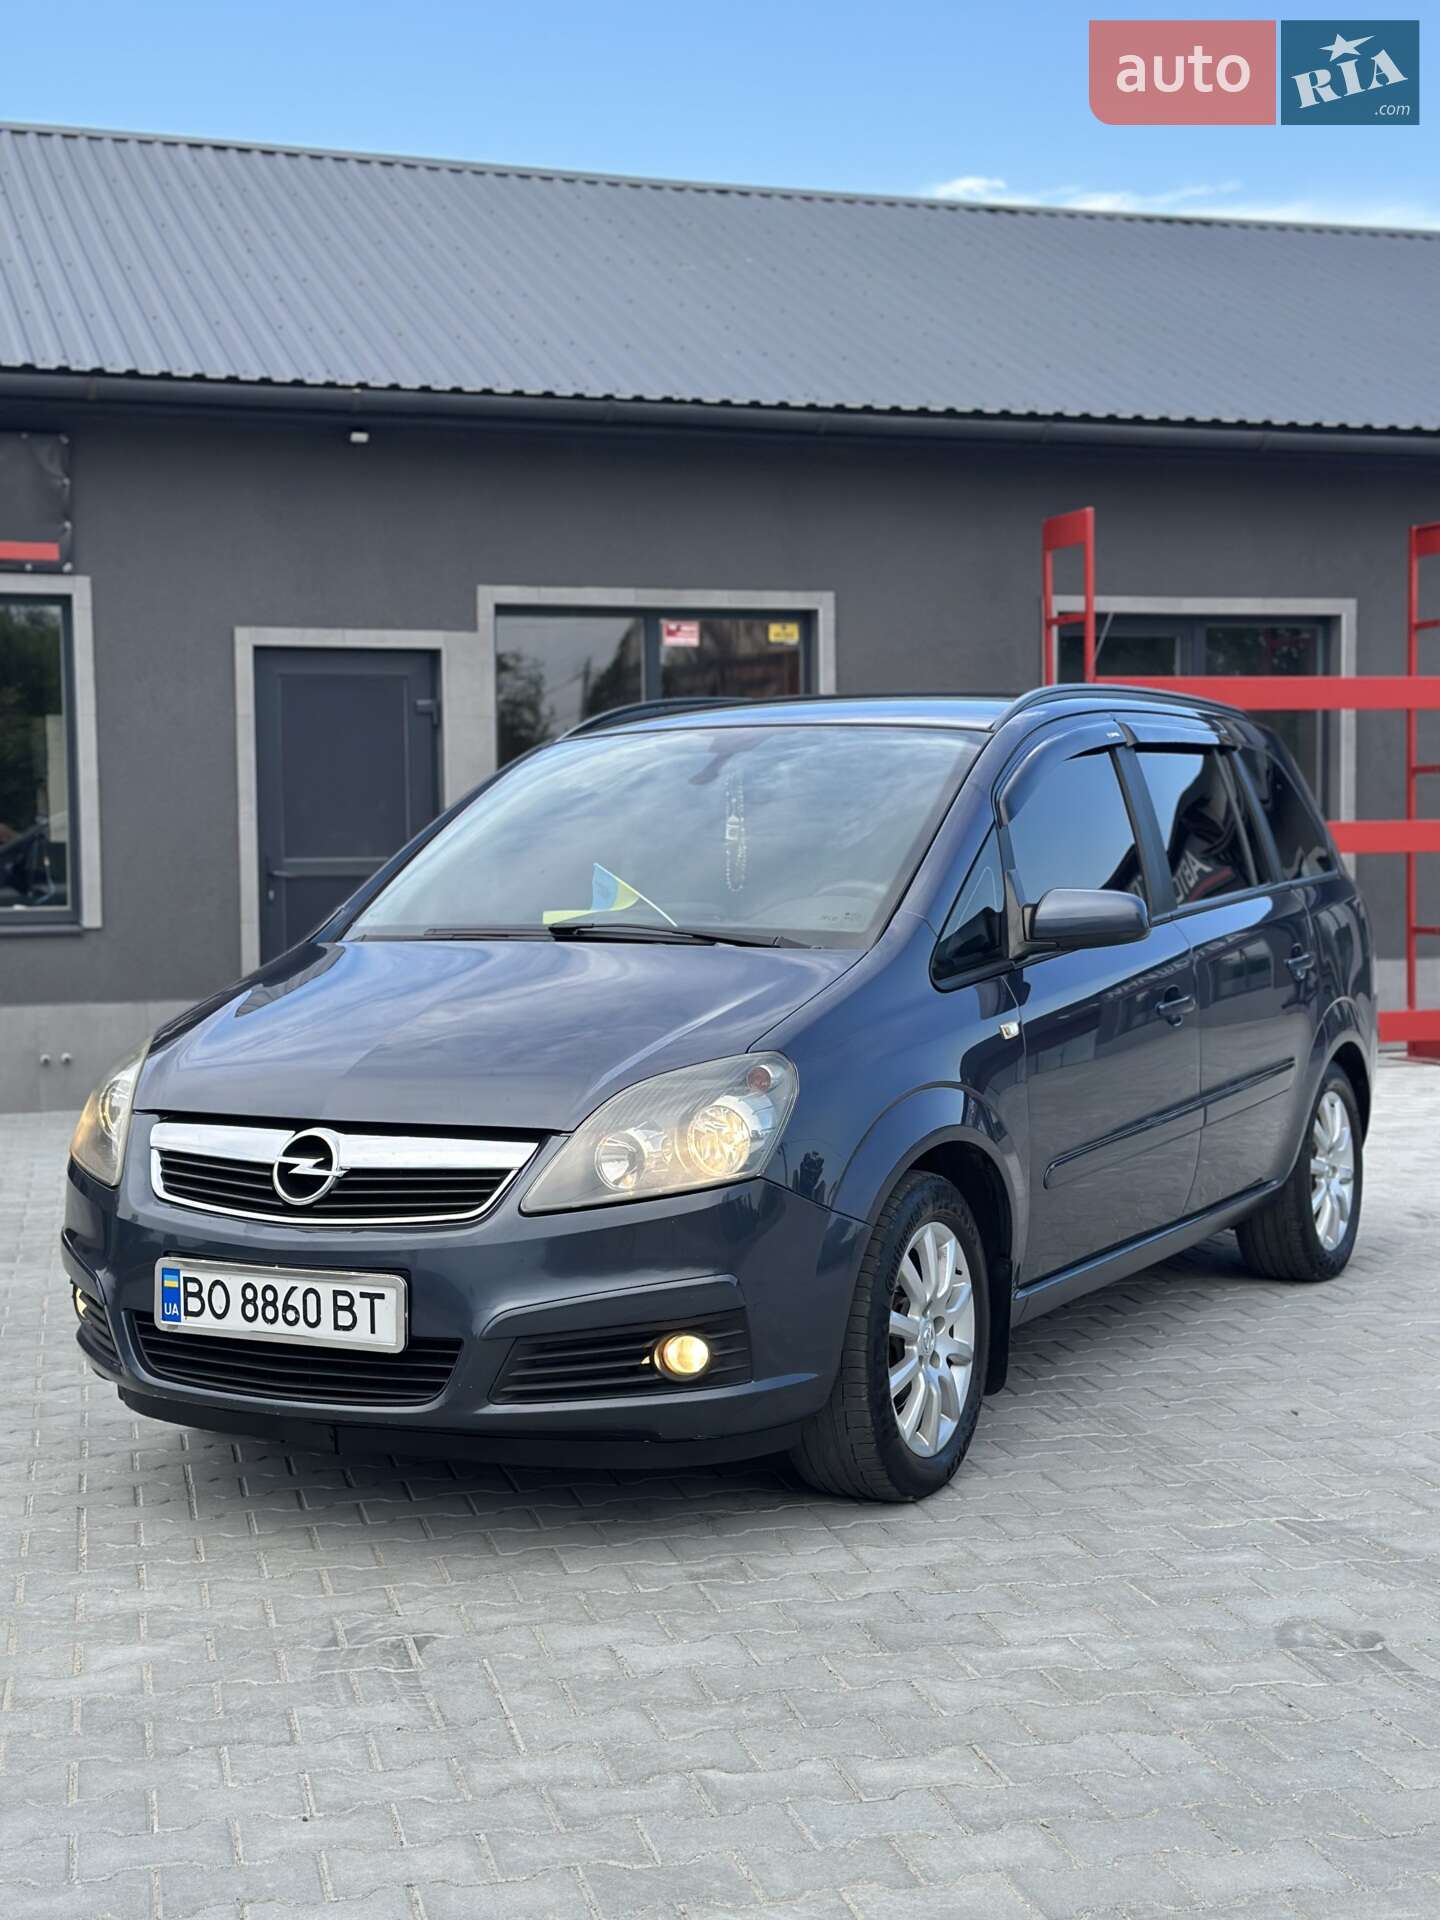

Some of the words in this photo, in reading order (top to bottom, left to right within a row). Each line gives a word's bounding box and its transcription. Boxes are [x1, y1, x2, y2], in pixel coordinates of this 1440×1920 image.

[164, 1302, 179, 1316] UA
[182, 1276, 231, 1320] BO
[241, 1281, 322, 1329] 8860
[332, 1289, 385, 1335] BT
